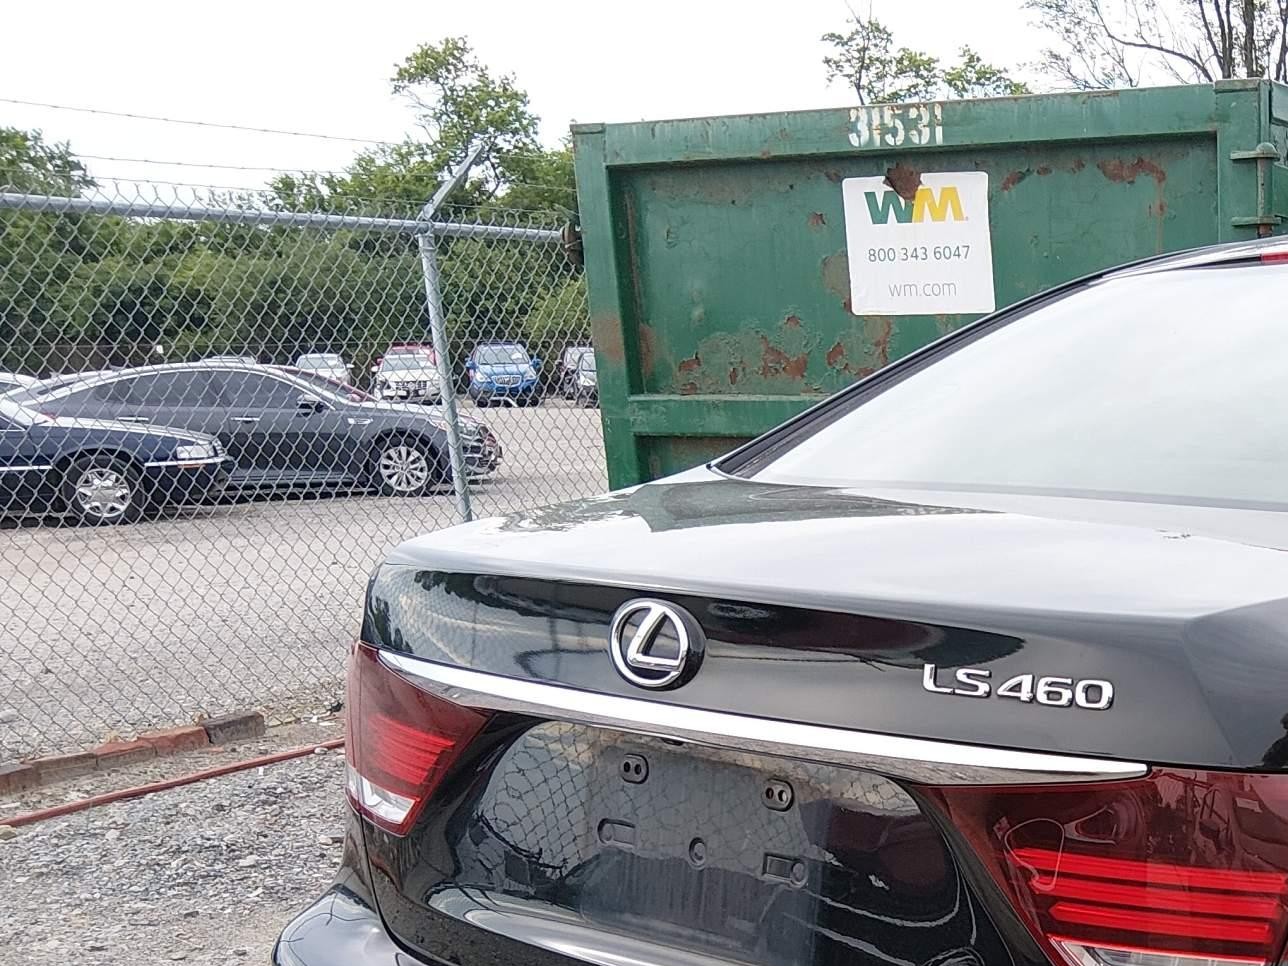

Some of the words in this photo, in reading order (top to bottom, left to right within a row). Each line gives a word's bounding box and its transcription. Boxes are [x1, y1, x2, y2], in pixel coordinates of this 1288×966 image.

[848, 103, 943, 147] 31531
[864, 186, 965, 225] WM
[867, 247, 897, 263] 800
[900, 246, 929, 262] 343
[933, 245, 971, 261] 6047
[888, 281, 957, 298] wm.com
